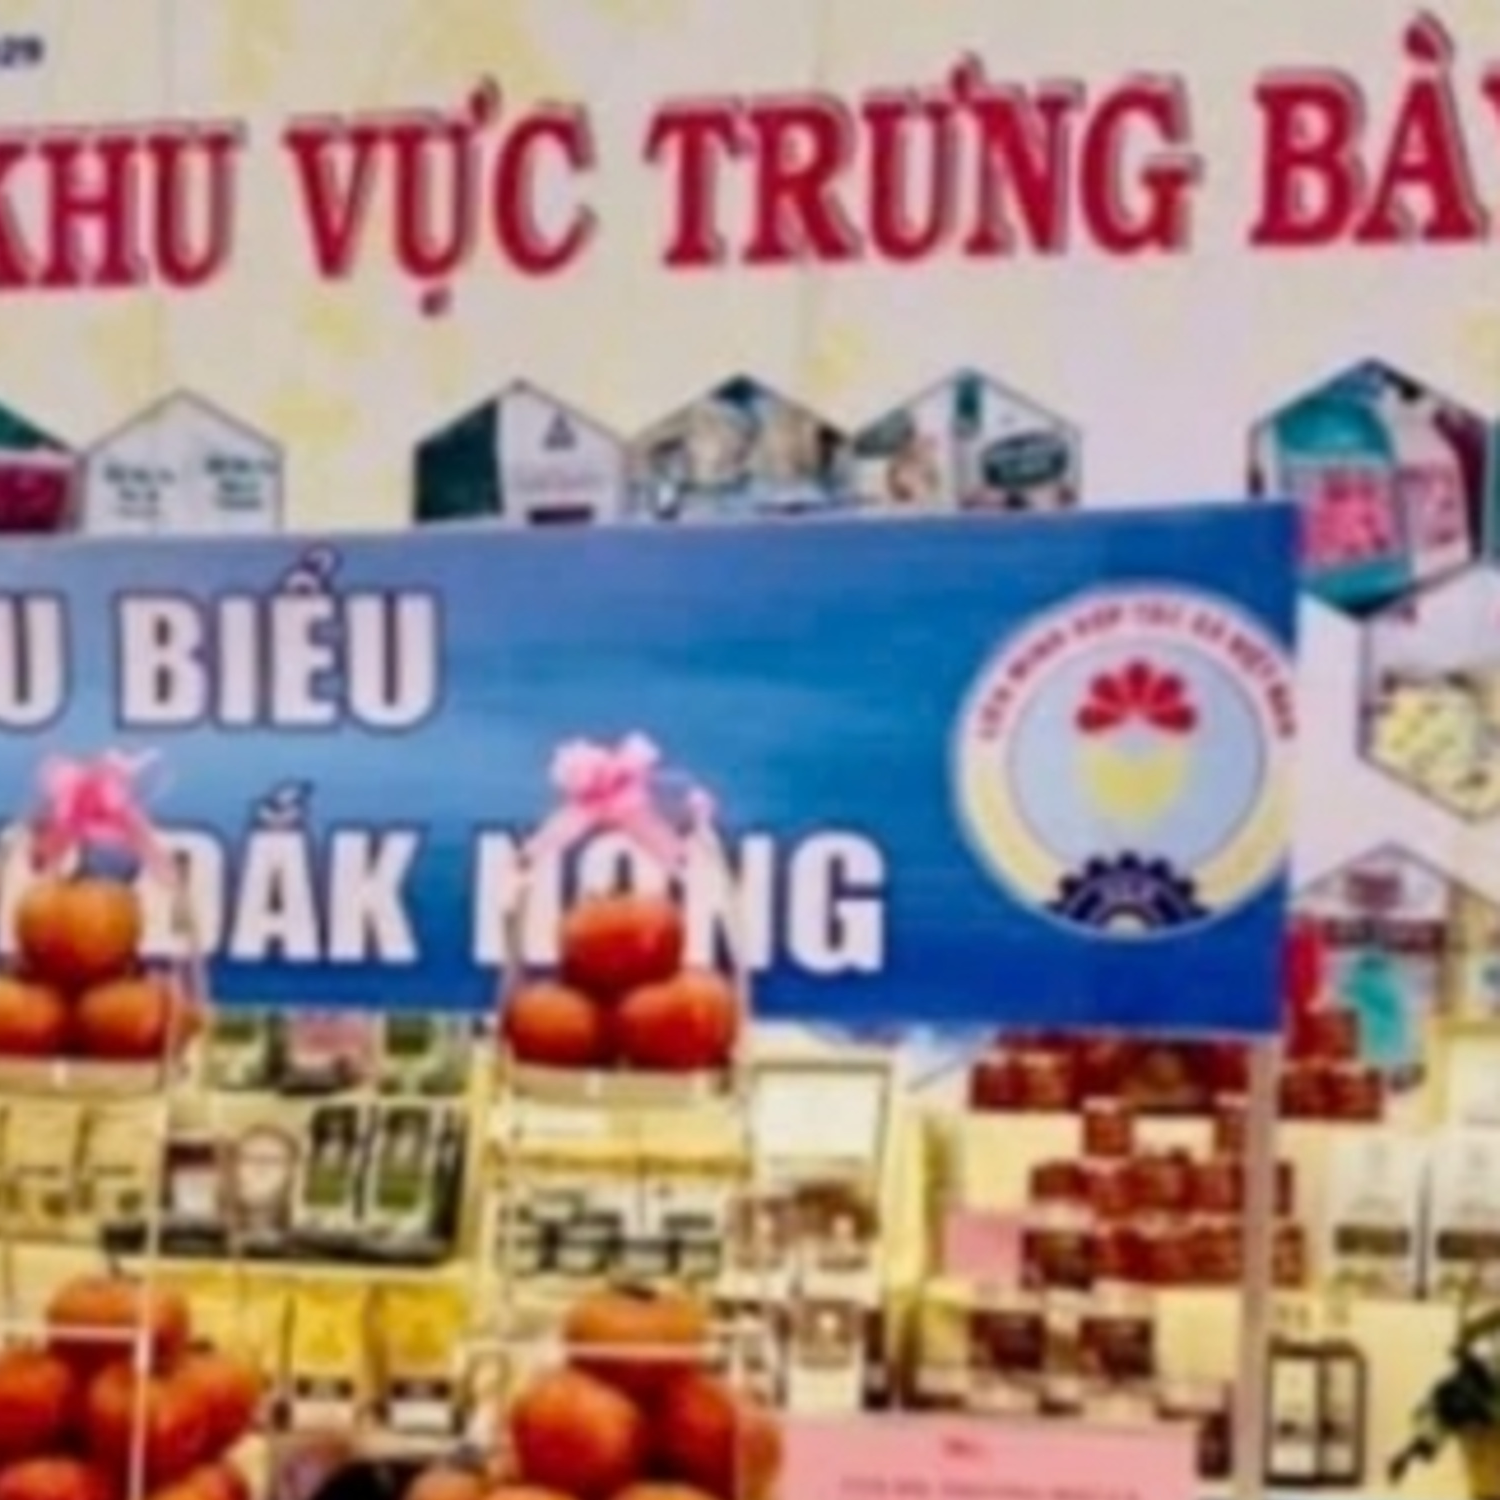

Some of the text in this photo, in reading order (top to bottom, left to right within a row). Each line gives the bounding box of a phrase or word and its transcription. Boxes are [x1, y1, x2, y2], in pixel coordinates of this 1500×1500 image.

[282, 72, 597, 318] VỰC
[643, 53, 1203, 268] TRƯNG
[1249, 10, 1500, 248] BÀ
[118, 548, 440, 727] BIỂU
